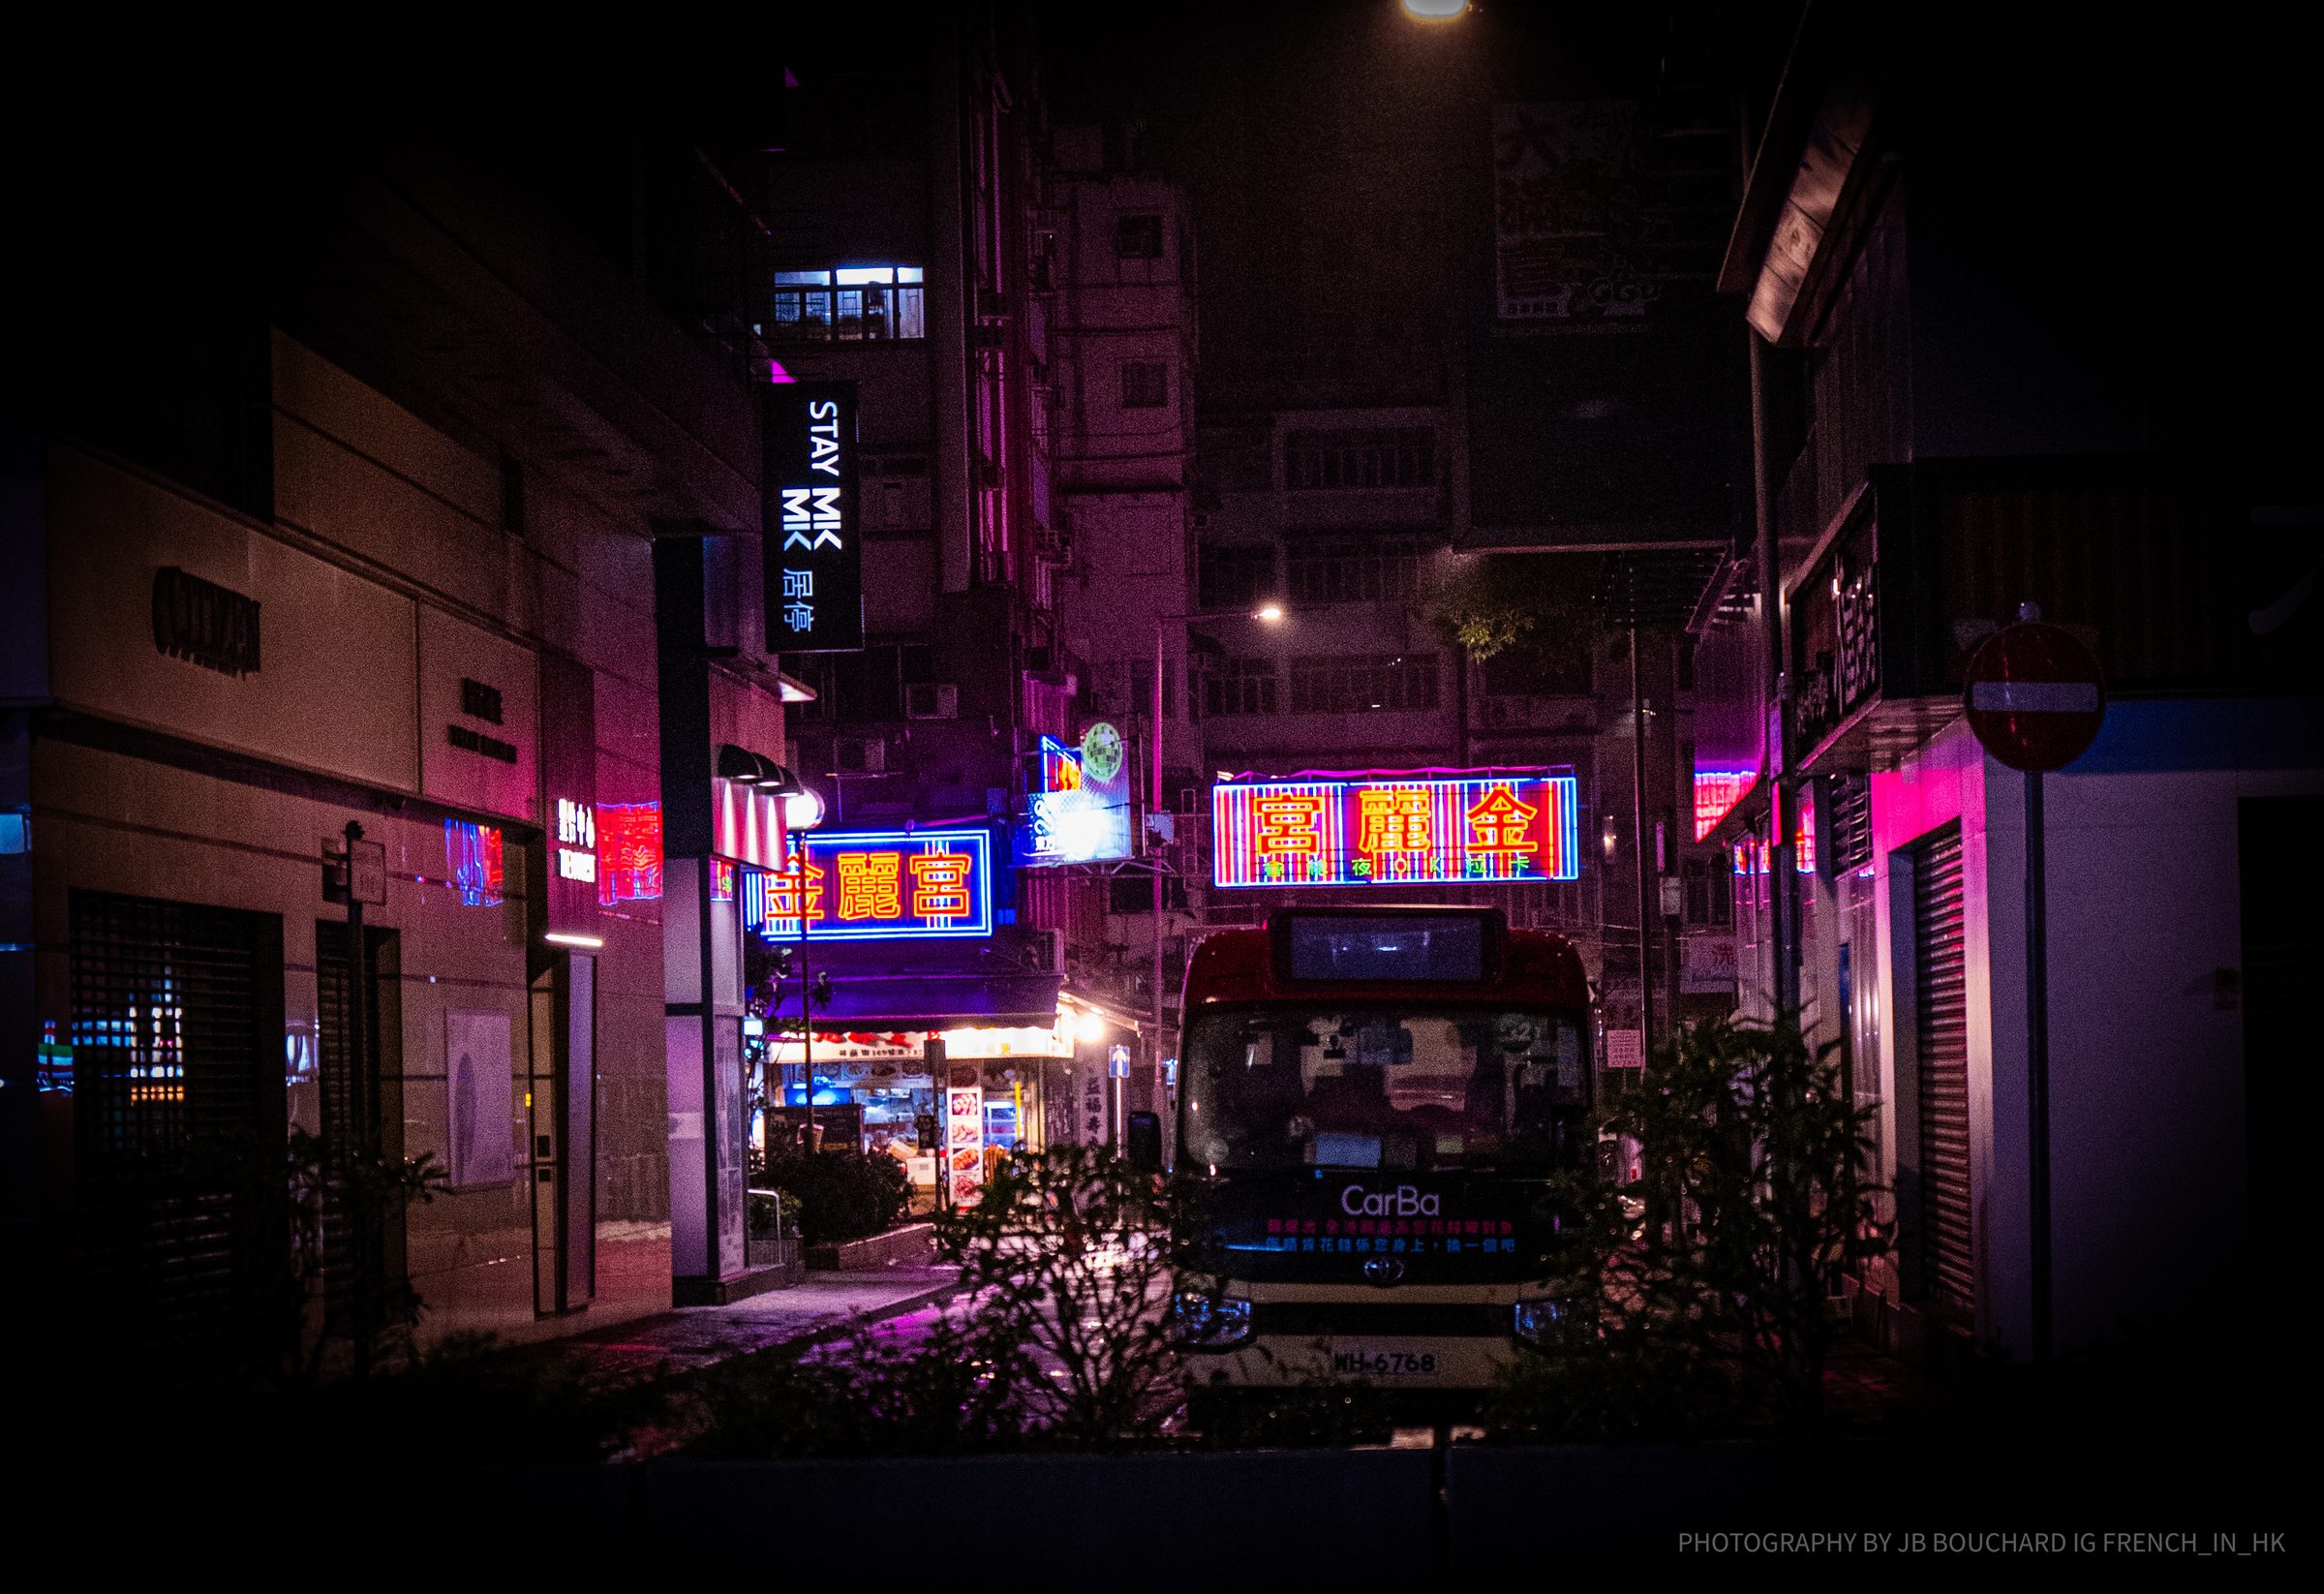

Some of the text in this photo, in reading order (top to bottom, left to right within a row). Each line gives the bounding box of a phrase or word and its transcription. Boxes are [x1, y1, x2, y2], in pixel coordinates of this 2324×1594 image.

[810, 400, 843, 551] STAY MK
[780, 487, 812, 552] MK
[782, 567, 815, 632] 居停
[1339, 1183, 1441, 1217] CarBa
